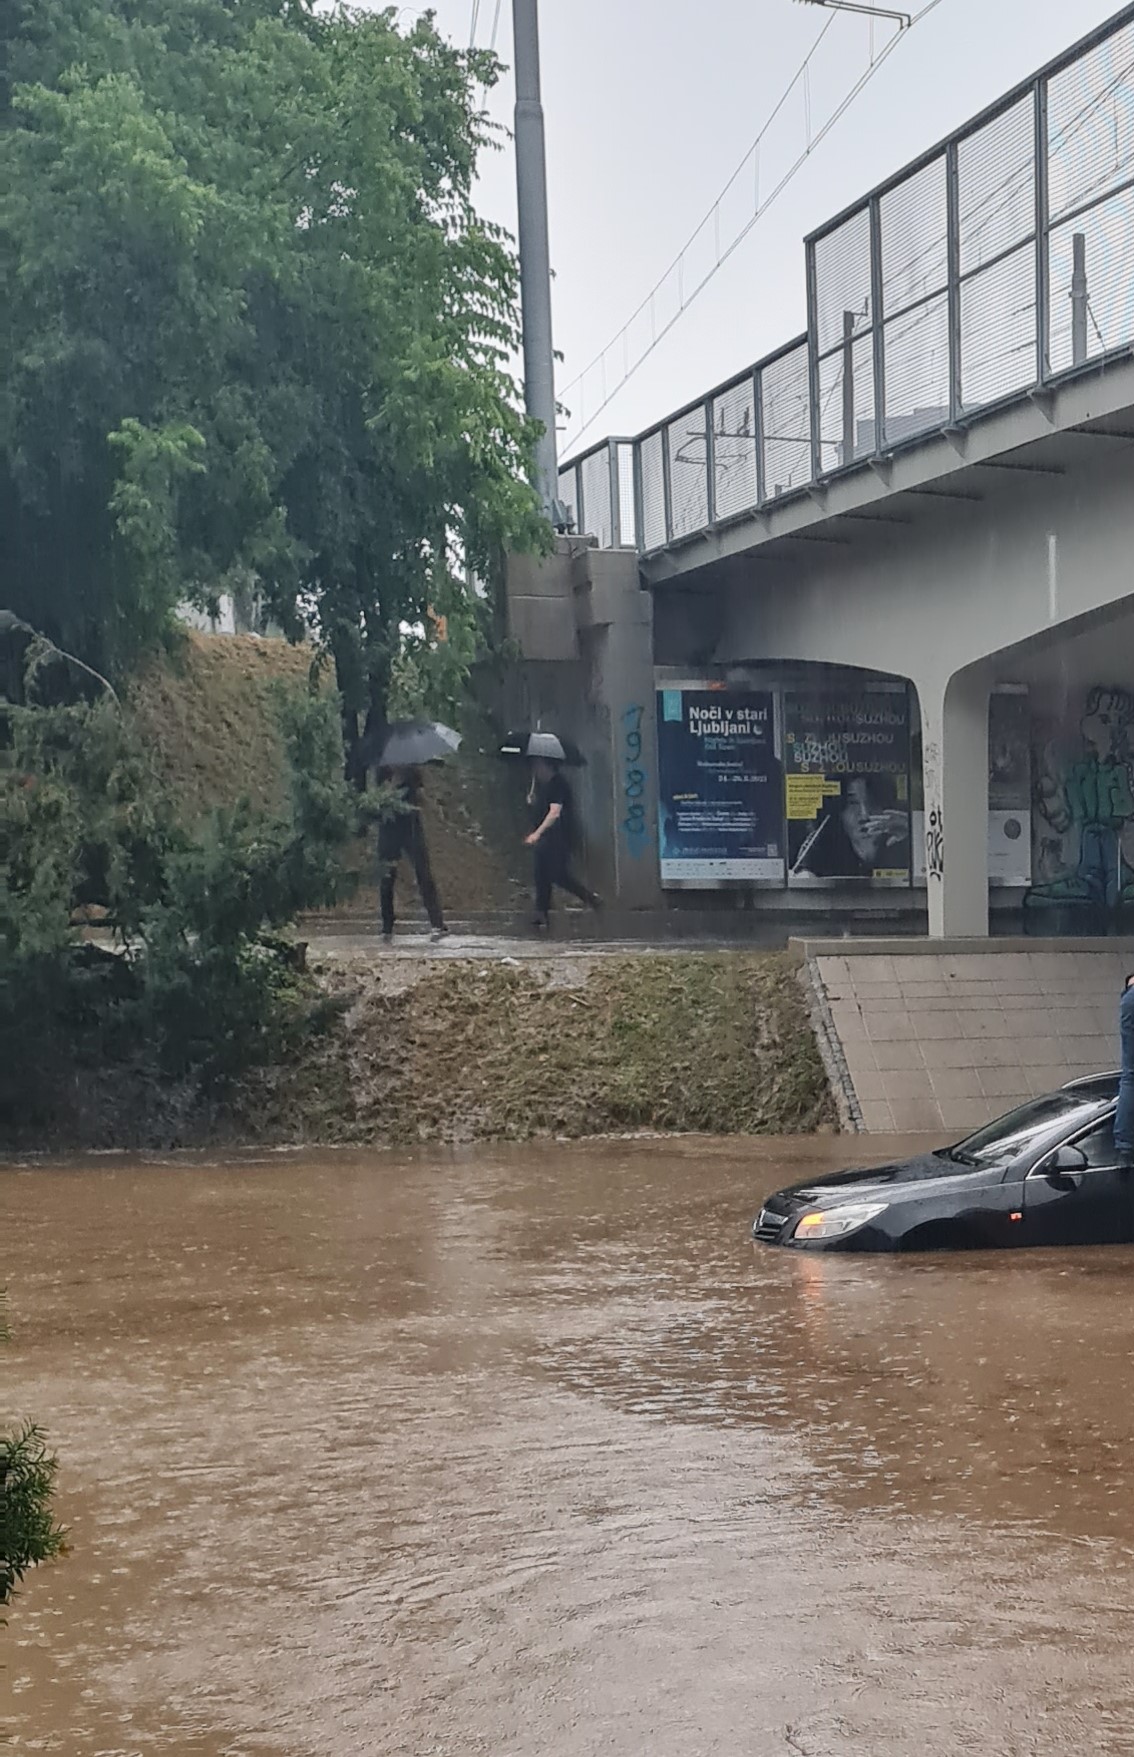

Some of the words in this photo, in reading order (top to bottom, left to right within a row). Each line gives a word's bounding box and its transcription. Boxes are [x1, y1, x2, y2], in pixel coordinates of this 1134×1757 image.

[689, 705, 722, 720] Noči
[725, 710, 734, 720] v
[736, 707, 768, 721] stari
[689, 720, 751, 736] Ljubljani
[842, 733, 895, 744] SUZHOU
[794, 752, 848, 764] SUZHOU
